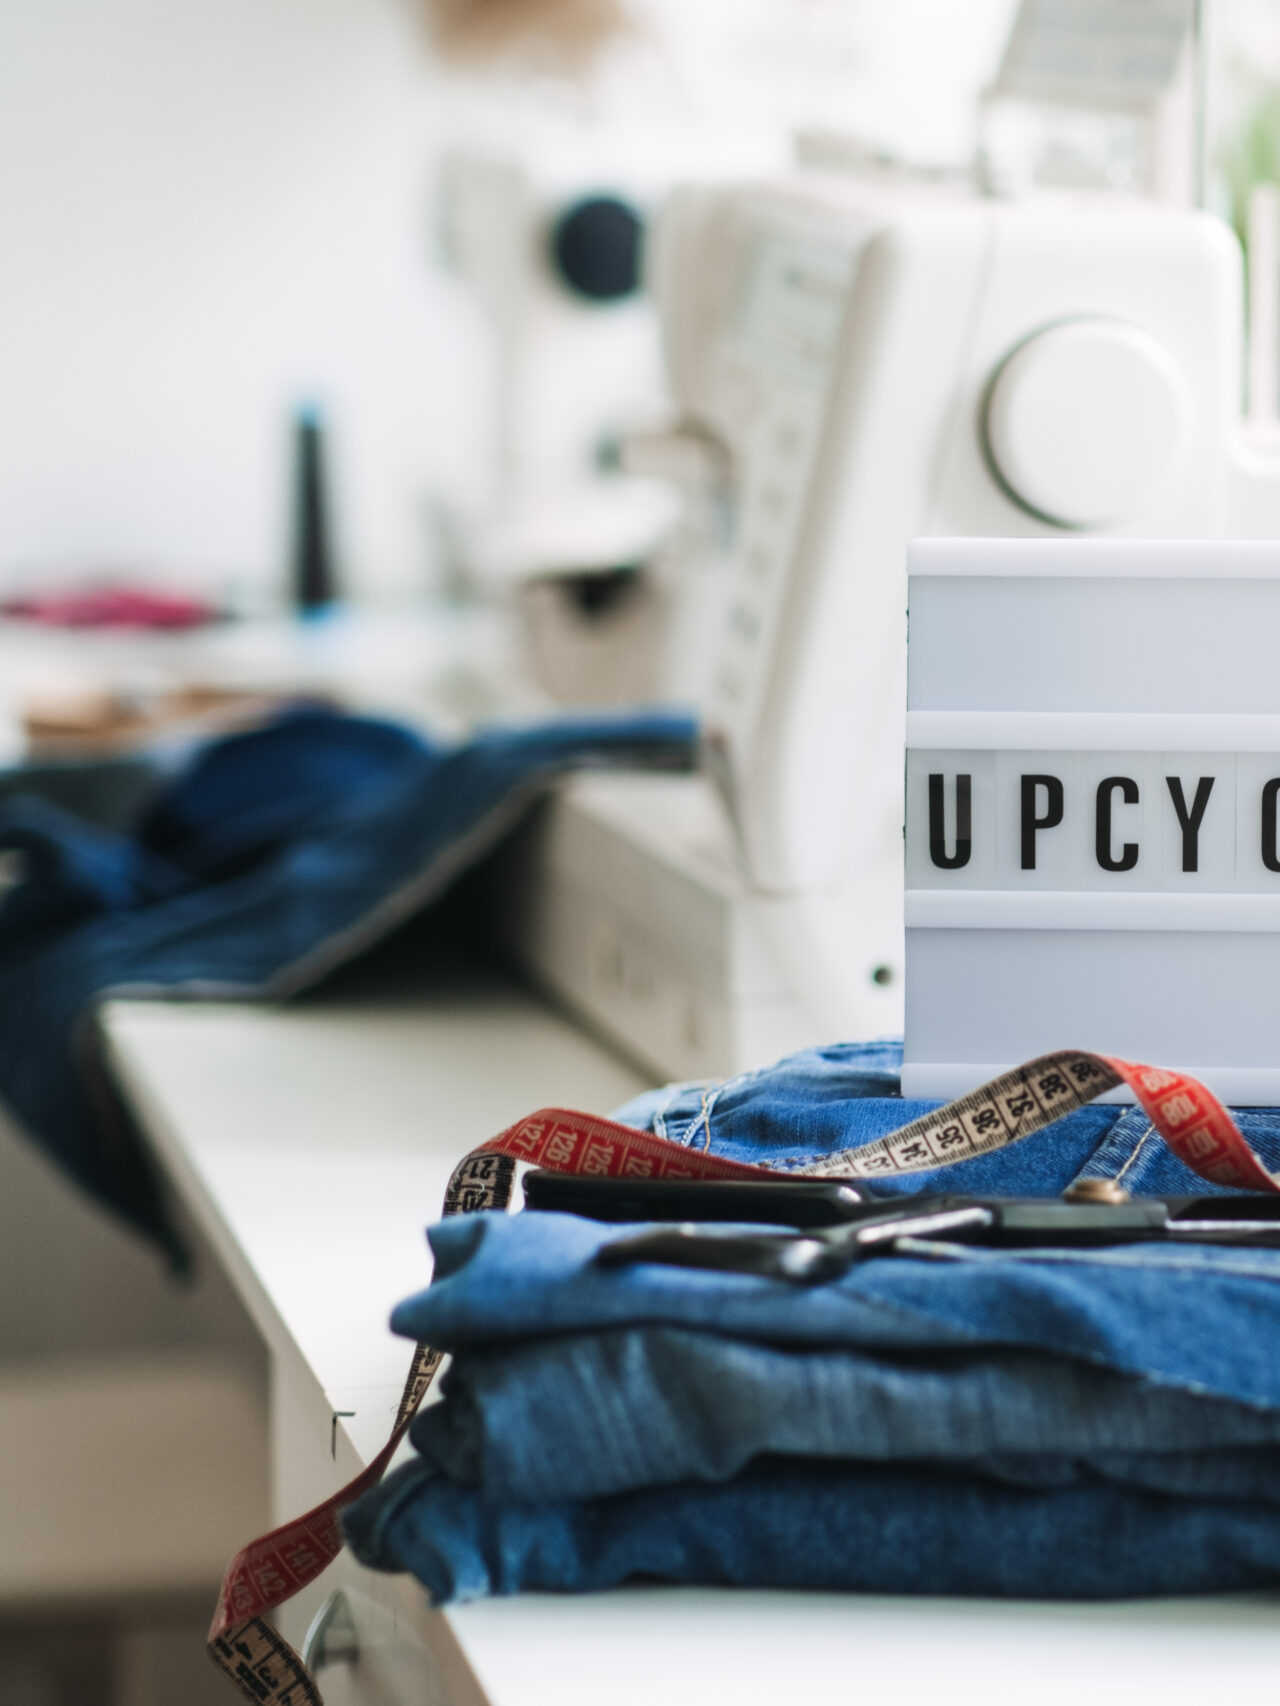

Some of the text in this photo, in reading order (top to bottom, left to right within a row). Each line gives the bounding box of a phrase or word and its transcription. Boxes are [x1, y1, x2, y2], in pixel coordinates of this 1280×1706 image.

[1070, 1060, 1098, 1083] 39
[1039, 1073, 1067, 1100] 38
[1006, 1093, 1035, 1118] 37
[971, 1107, 1001, 1135] 36
[514, 1120, 545, 1152] 127
[546, 1130, 578, 1165] 126
[935, 1124, 965, 1149] 35
[900, 1141, 929, 1163] 34
[469, 1159, 495, 1180] 21
[254, 1561, 287, 1597] 142
